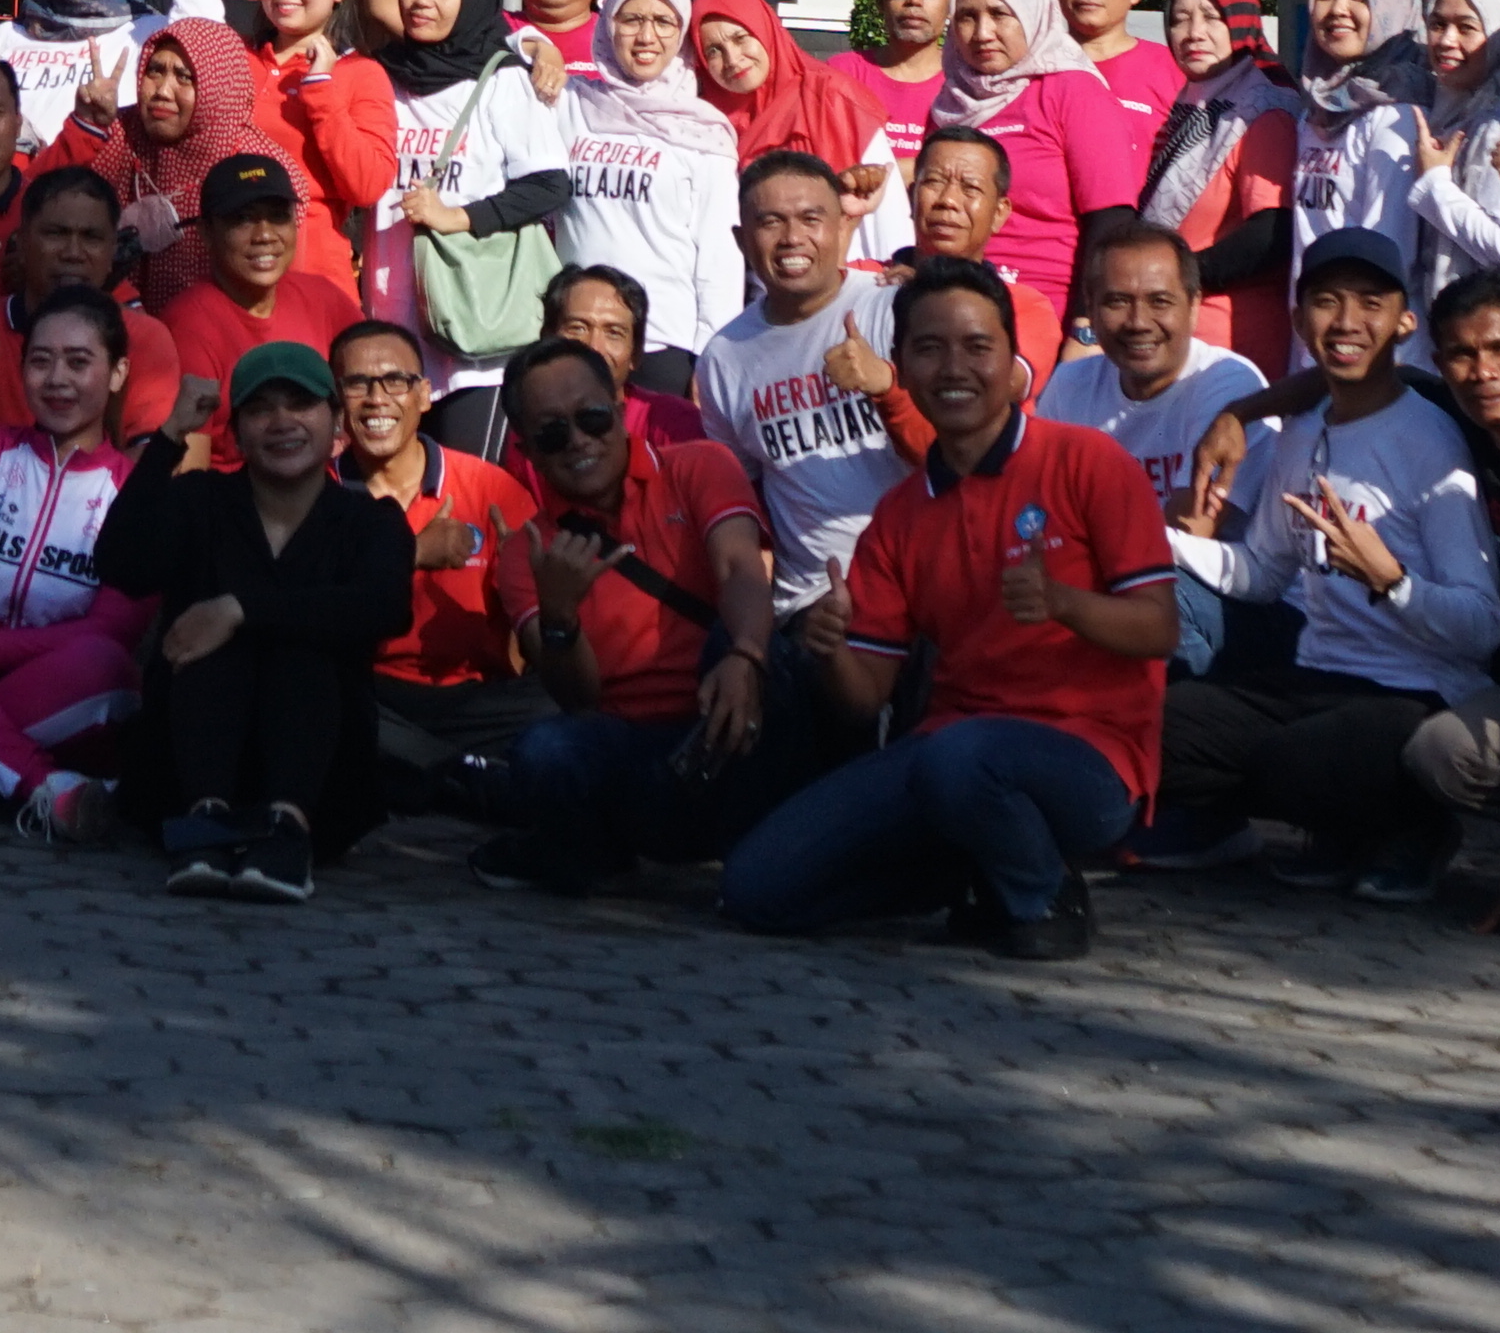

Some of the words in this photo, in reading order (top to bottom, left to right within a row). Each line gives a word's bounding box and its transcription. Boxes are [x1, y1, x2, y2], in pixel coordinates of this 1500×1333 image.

[18, 63, 94, 91] LAJAR
[568, 136, 662, 171] MERDEKA
[753, 372, 863, 423] MERDE
[761, 396, 884, 460] BELAJAR
